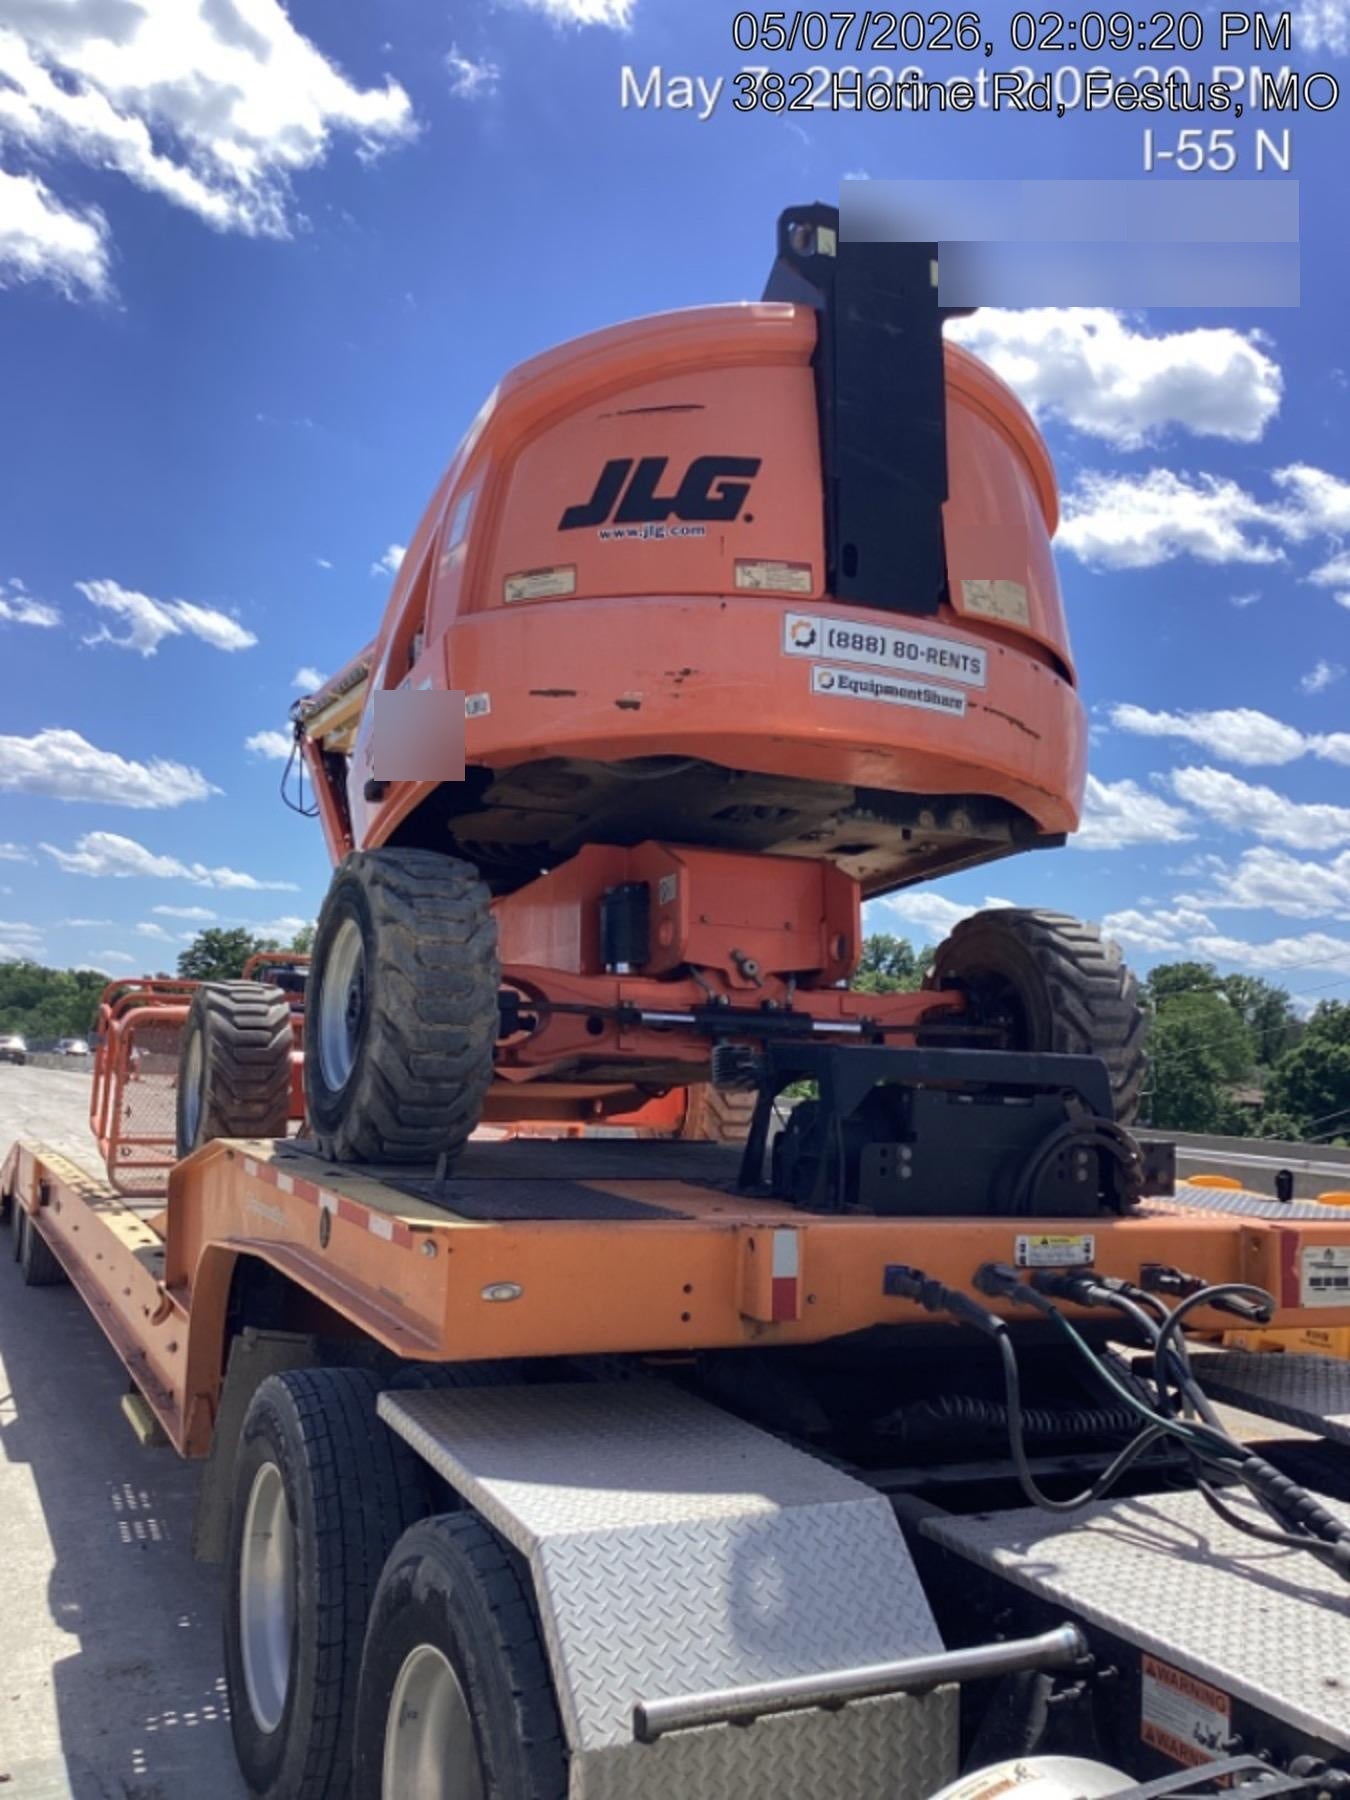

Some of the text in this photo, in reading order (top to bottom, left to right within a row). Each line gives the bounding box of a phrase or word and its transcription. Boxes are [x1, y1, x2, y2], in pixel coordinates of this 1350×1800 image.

[600, 524, 706, 540] www.jlg.com
[827, 628, 982, 675] (888) 80-RENTS
[837, 673, 964, 710] EquipmentShare
[1157, 1663, 1227, 1714] WARNING
